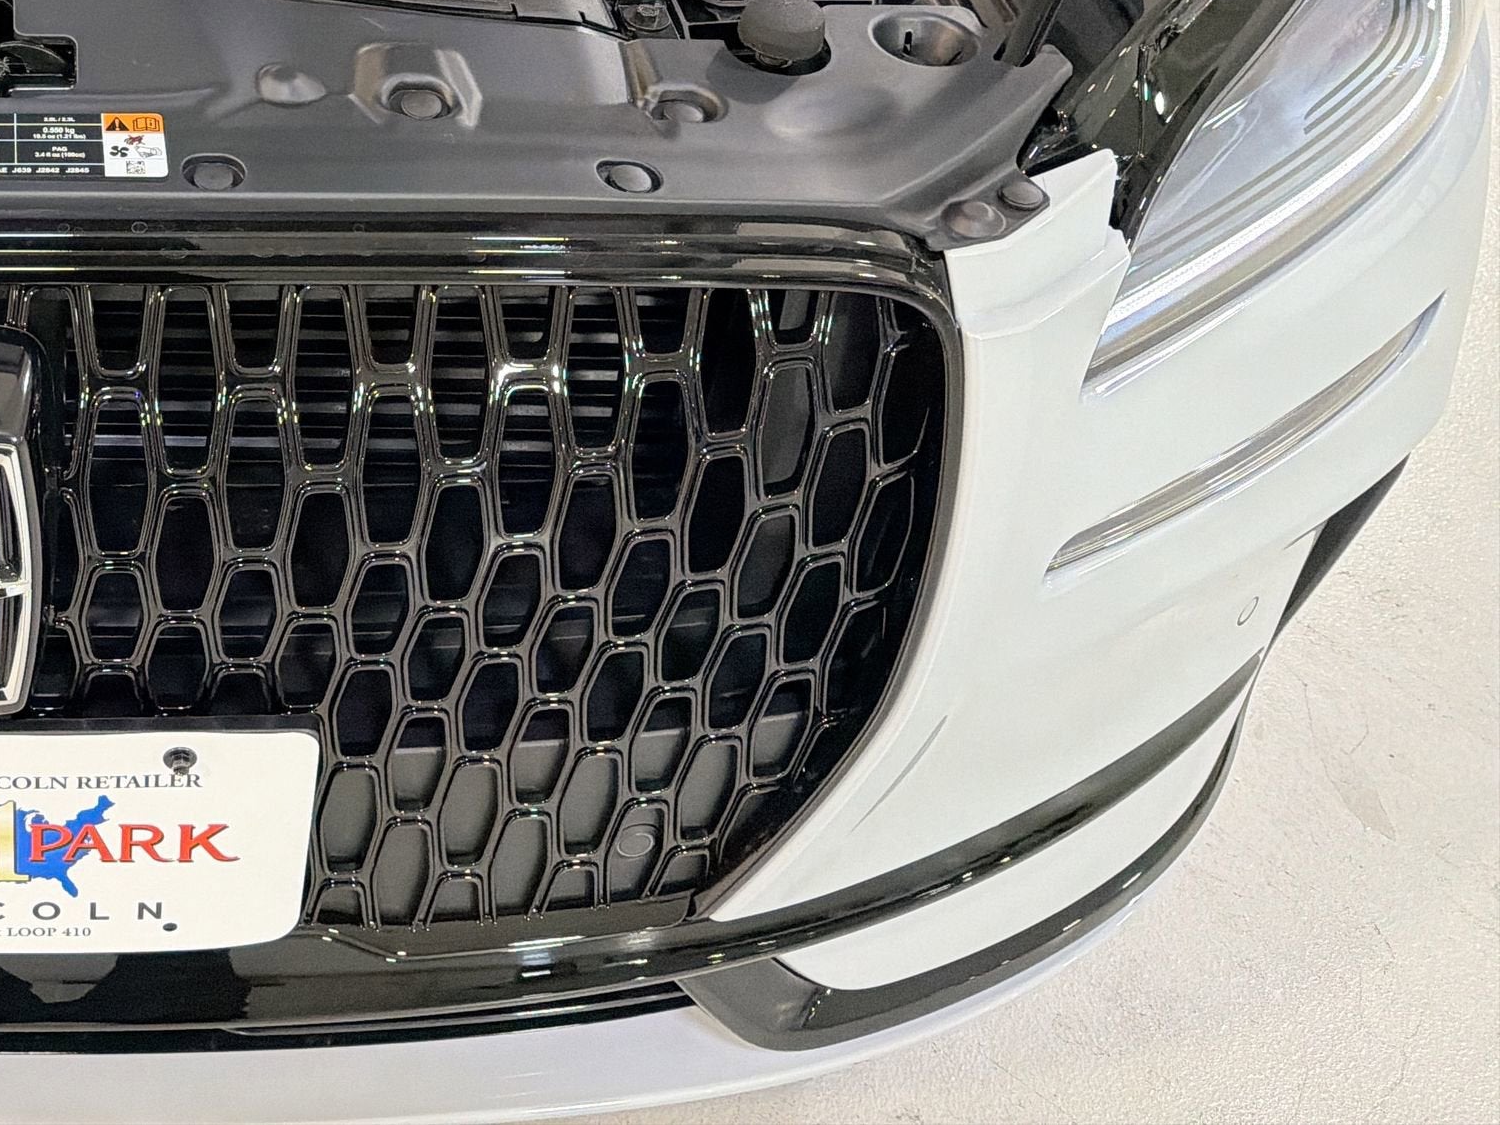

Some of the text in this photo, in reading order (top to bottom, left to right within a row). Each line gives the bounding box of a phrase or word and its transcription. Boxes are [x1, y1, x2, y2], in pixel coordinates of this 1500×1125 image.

[64, 127, 75, 135] kg
[77, 774, 204, 789] RETAILER
[28, 823, 241, 863] PARK
[7, 926, 57, 938] LOOP
[62, 926, 92, 937] 410
